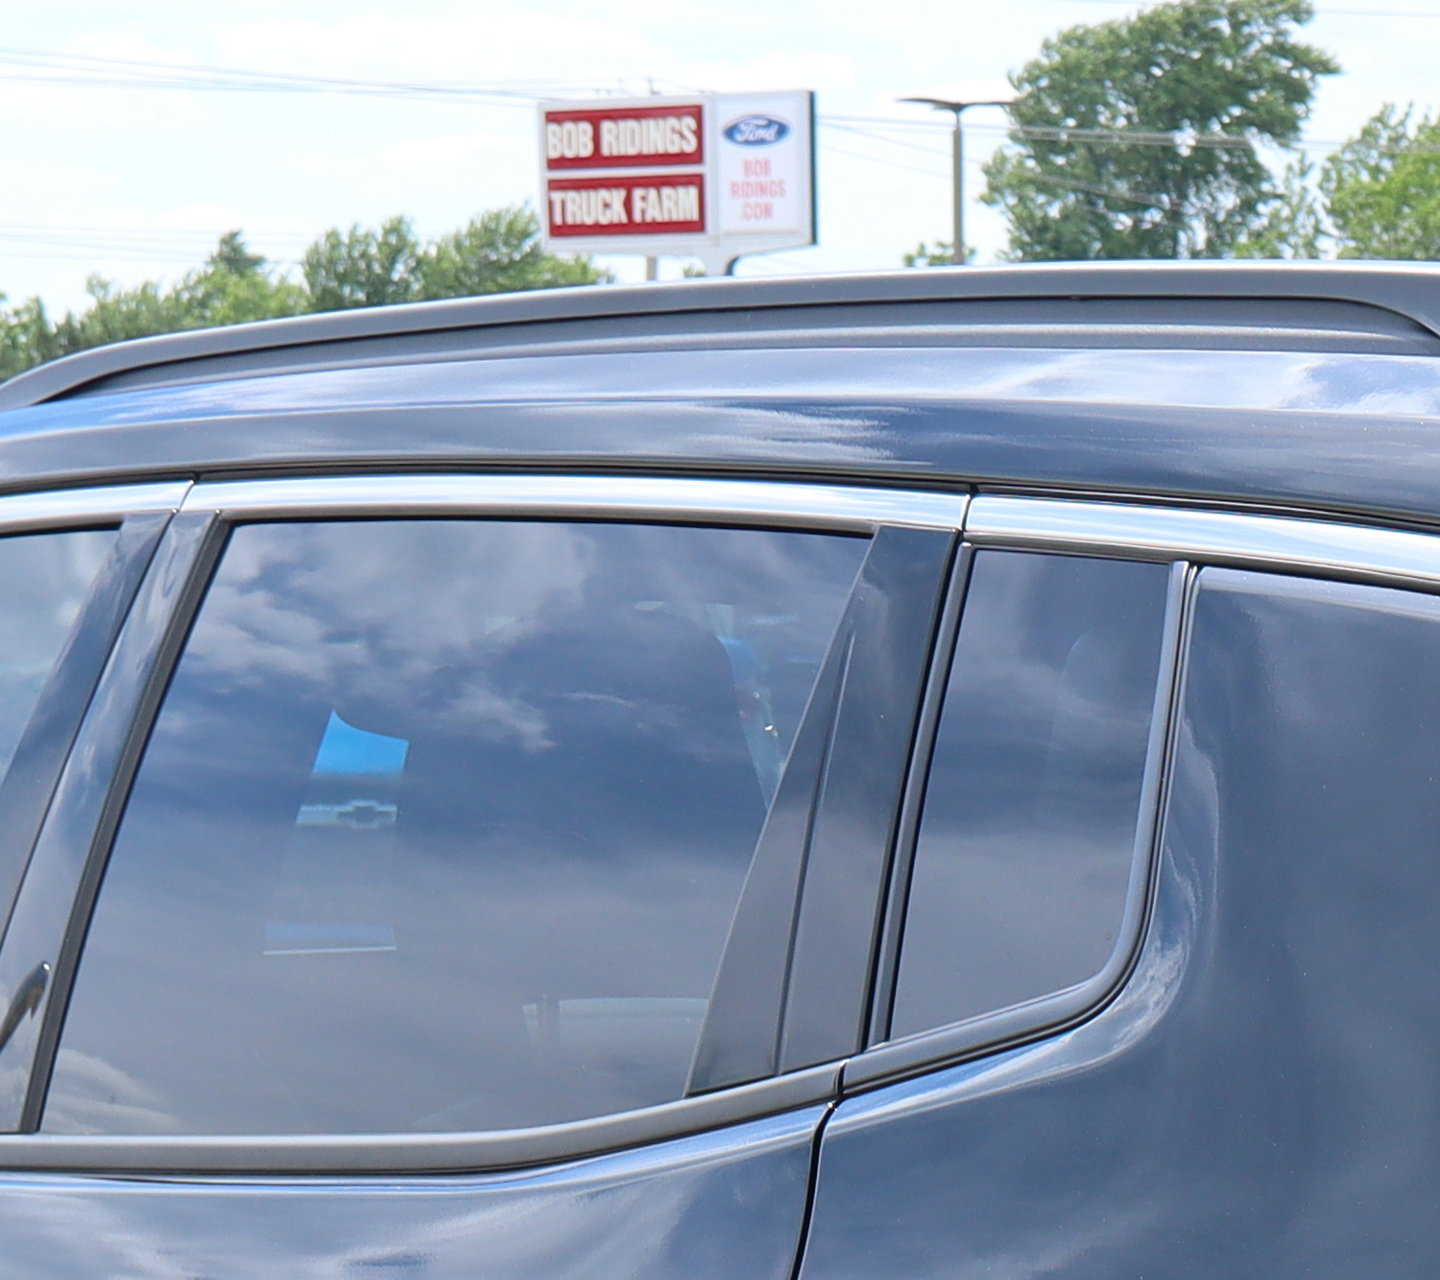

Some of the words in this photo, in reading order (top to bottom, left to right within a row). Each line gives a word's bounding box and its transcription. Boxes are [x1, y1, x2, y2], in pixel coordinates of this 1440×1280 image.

[547, 120, 594, 158] BOB
[601, 115, 697, 156] RIDINGS
[743, 158, 771, 177] BOB
[730, 179, 786, 198] RIDINGS
[550, 186, 627, 226] TRUCK
[632, 184, 699, 223] FARM
